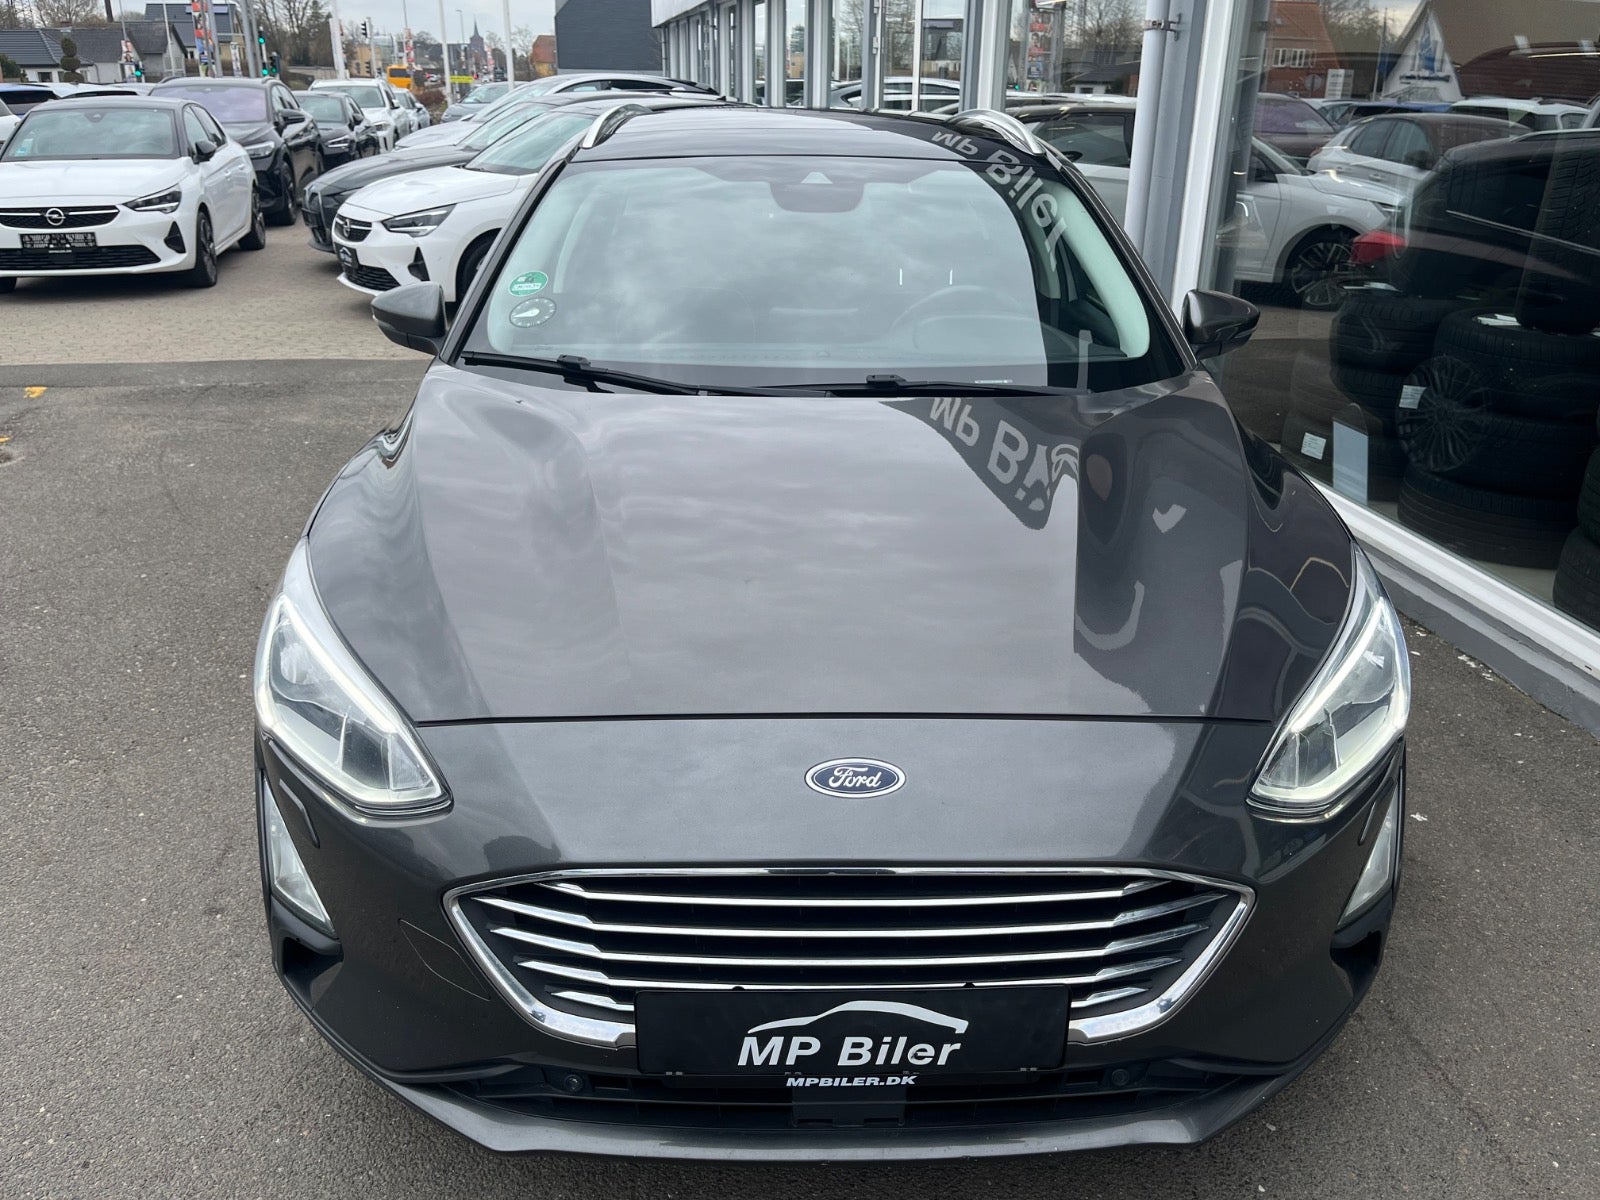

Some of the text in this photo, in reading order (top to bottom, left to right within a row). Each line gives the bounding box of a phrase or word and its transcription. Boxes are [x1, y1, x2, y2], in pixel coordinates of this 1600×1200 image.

[828, 766, 882, 788] Ford
[737, 1036, 961, 1066] MP Biler
[786, 1075, 918, 1087] MPBILER.DK
